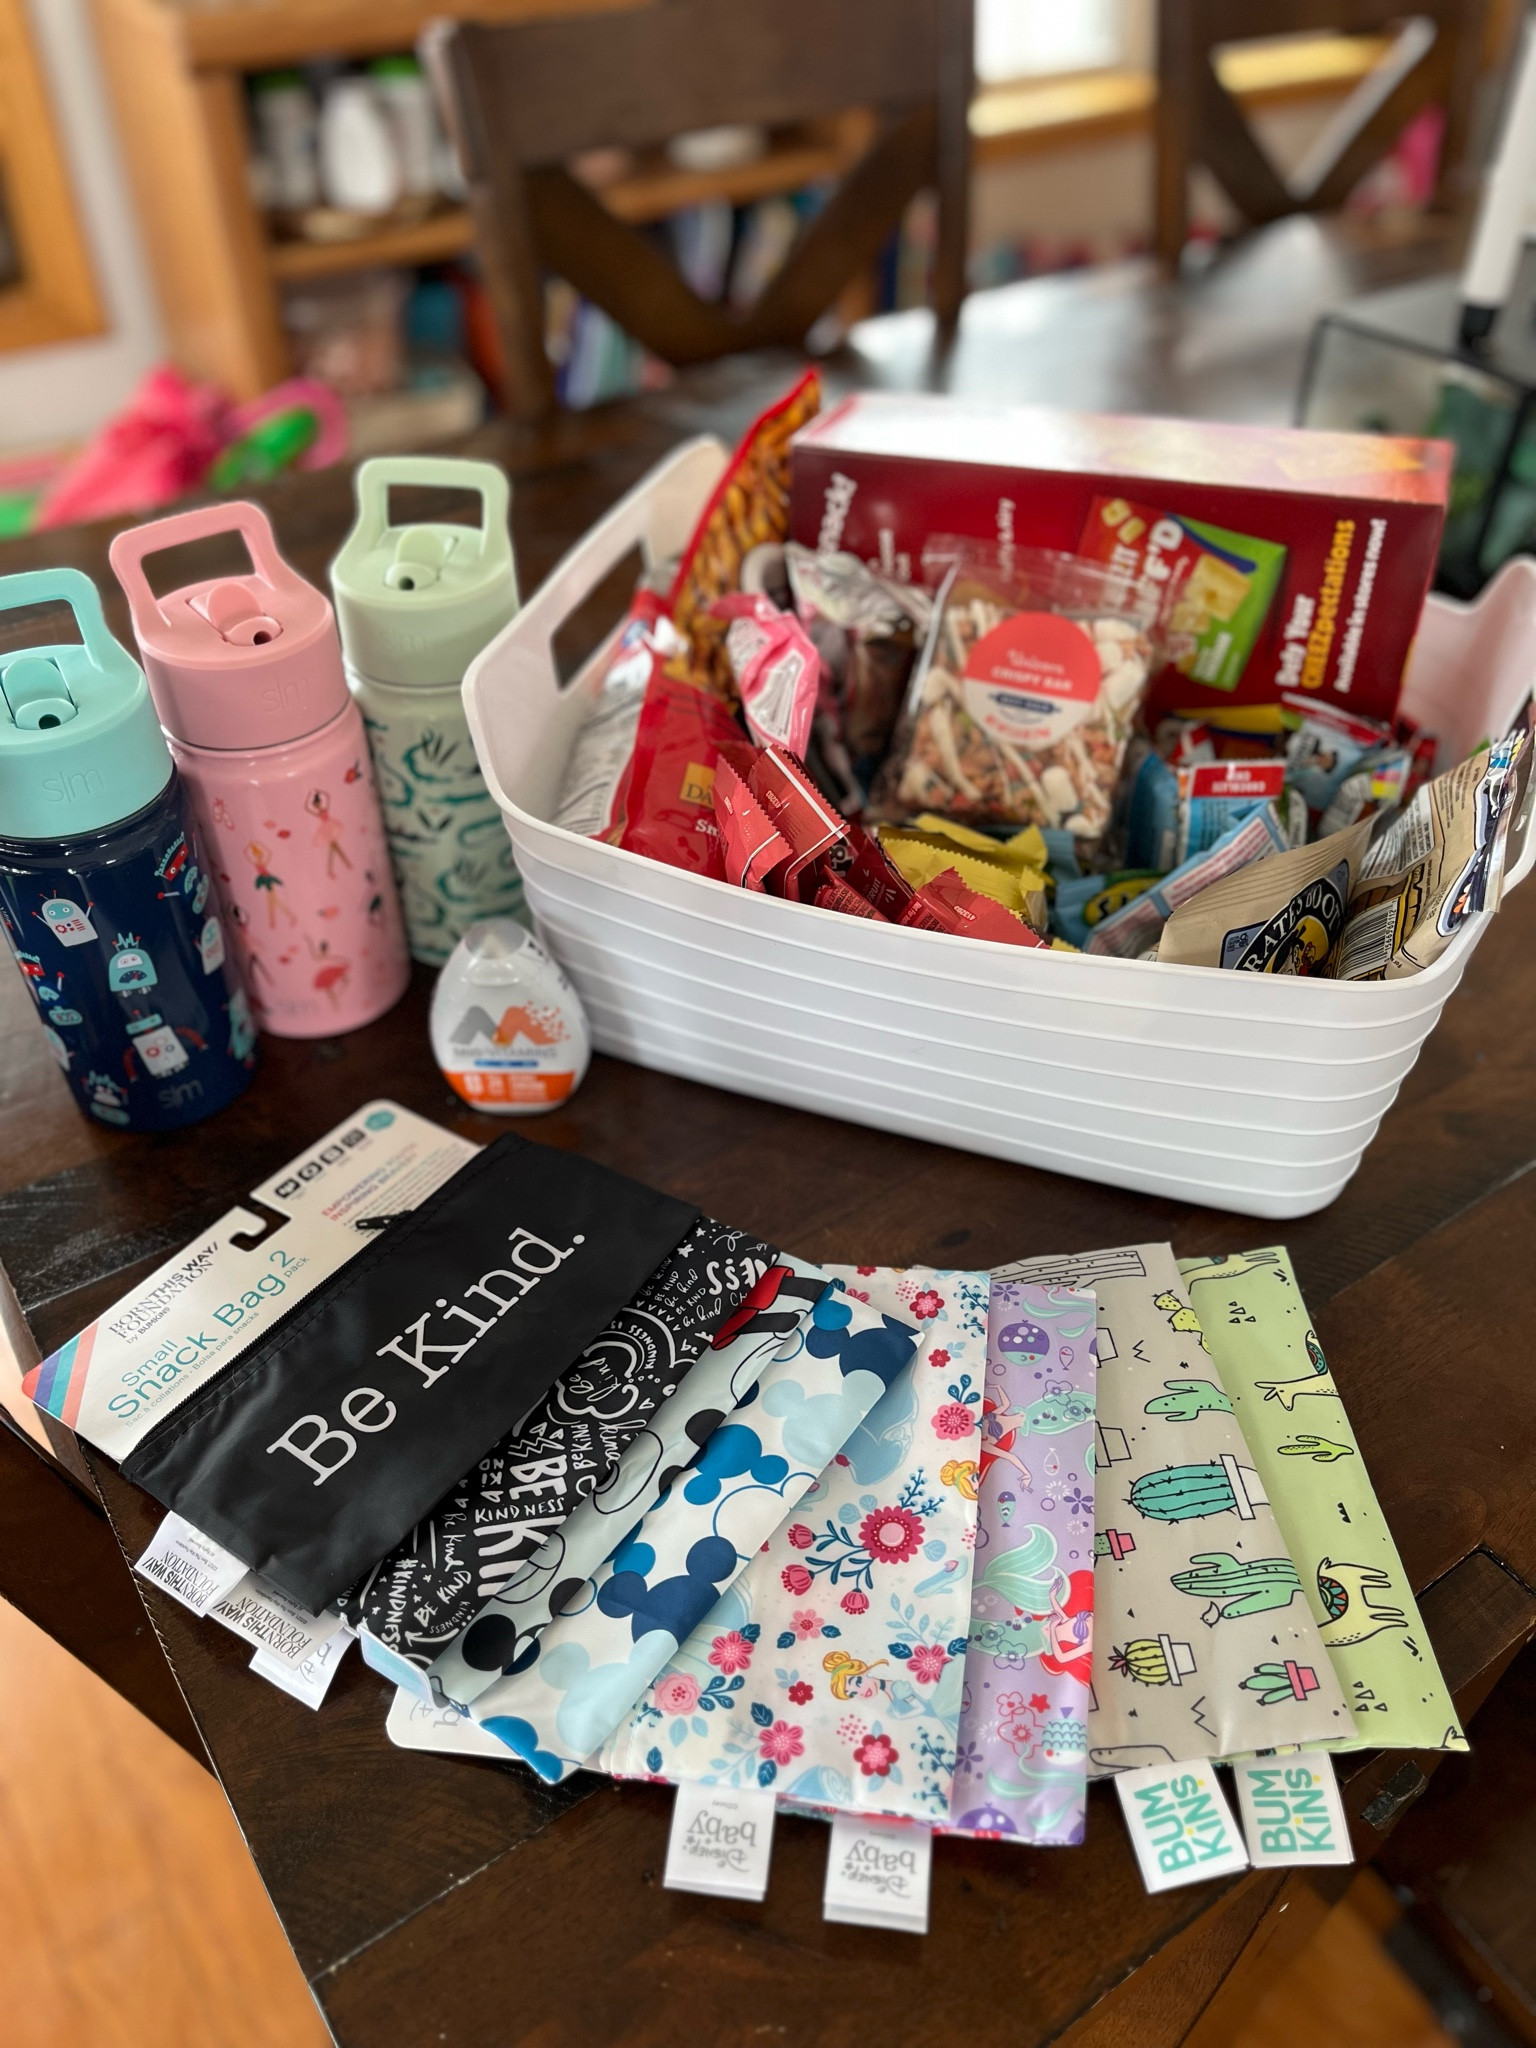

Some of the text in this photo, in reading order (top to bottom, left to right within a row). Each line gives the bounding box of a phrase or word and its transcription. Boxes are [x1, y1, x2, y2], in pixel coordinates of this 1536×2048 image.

[117, 1260, 214, 1339] FOUNDATION
[654, 1270, 679, 1301] BE KIND
[676, 1287, 706, 1315] BE KIND
[677, 1268, 699, 1293] kind
[108, 1250, 310, 1419] Snack Bag 2 pack
[126, 1307, 171, 1344] by BUMKINS
[628, 1325, 657, 1369] KINDNESS
[121, 1339, 178, 1387] Small
[125, 1412, 143, 1428] Sac
[151, 1373, 189, 1408] collations
[192, 1349, 216, 1371] Bolsa
[215, 1334, 233, 1352] para
[233, 1311, 260, 1335] snacks
[265, 1226, 586, 1486] Be Kind.
[509, 1454, 567, 1500] BE
[474, 1497, 565, 1523] KINDNESS
[159, 1548, 220, 1597] FOUNDATION
[236, 1592, 312, 1652] FOUNDATION
[414, 1570, 471, 1627] BE KIND
[429, 1601, 471, 1634] KINDNESS
[687, 1810, 757, 1846] baby
[1134, 1782, 1197, 1873] BUM
[1247, 1770, 1297, 1853] BUM
[846, 1838, 917, 1873] baby
